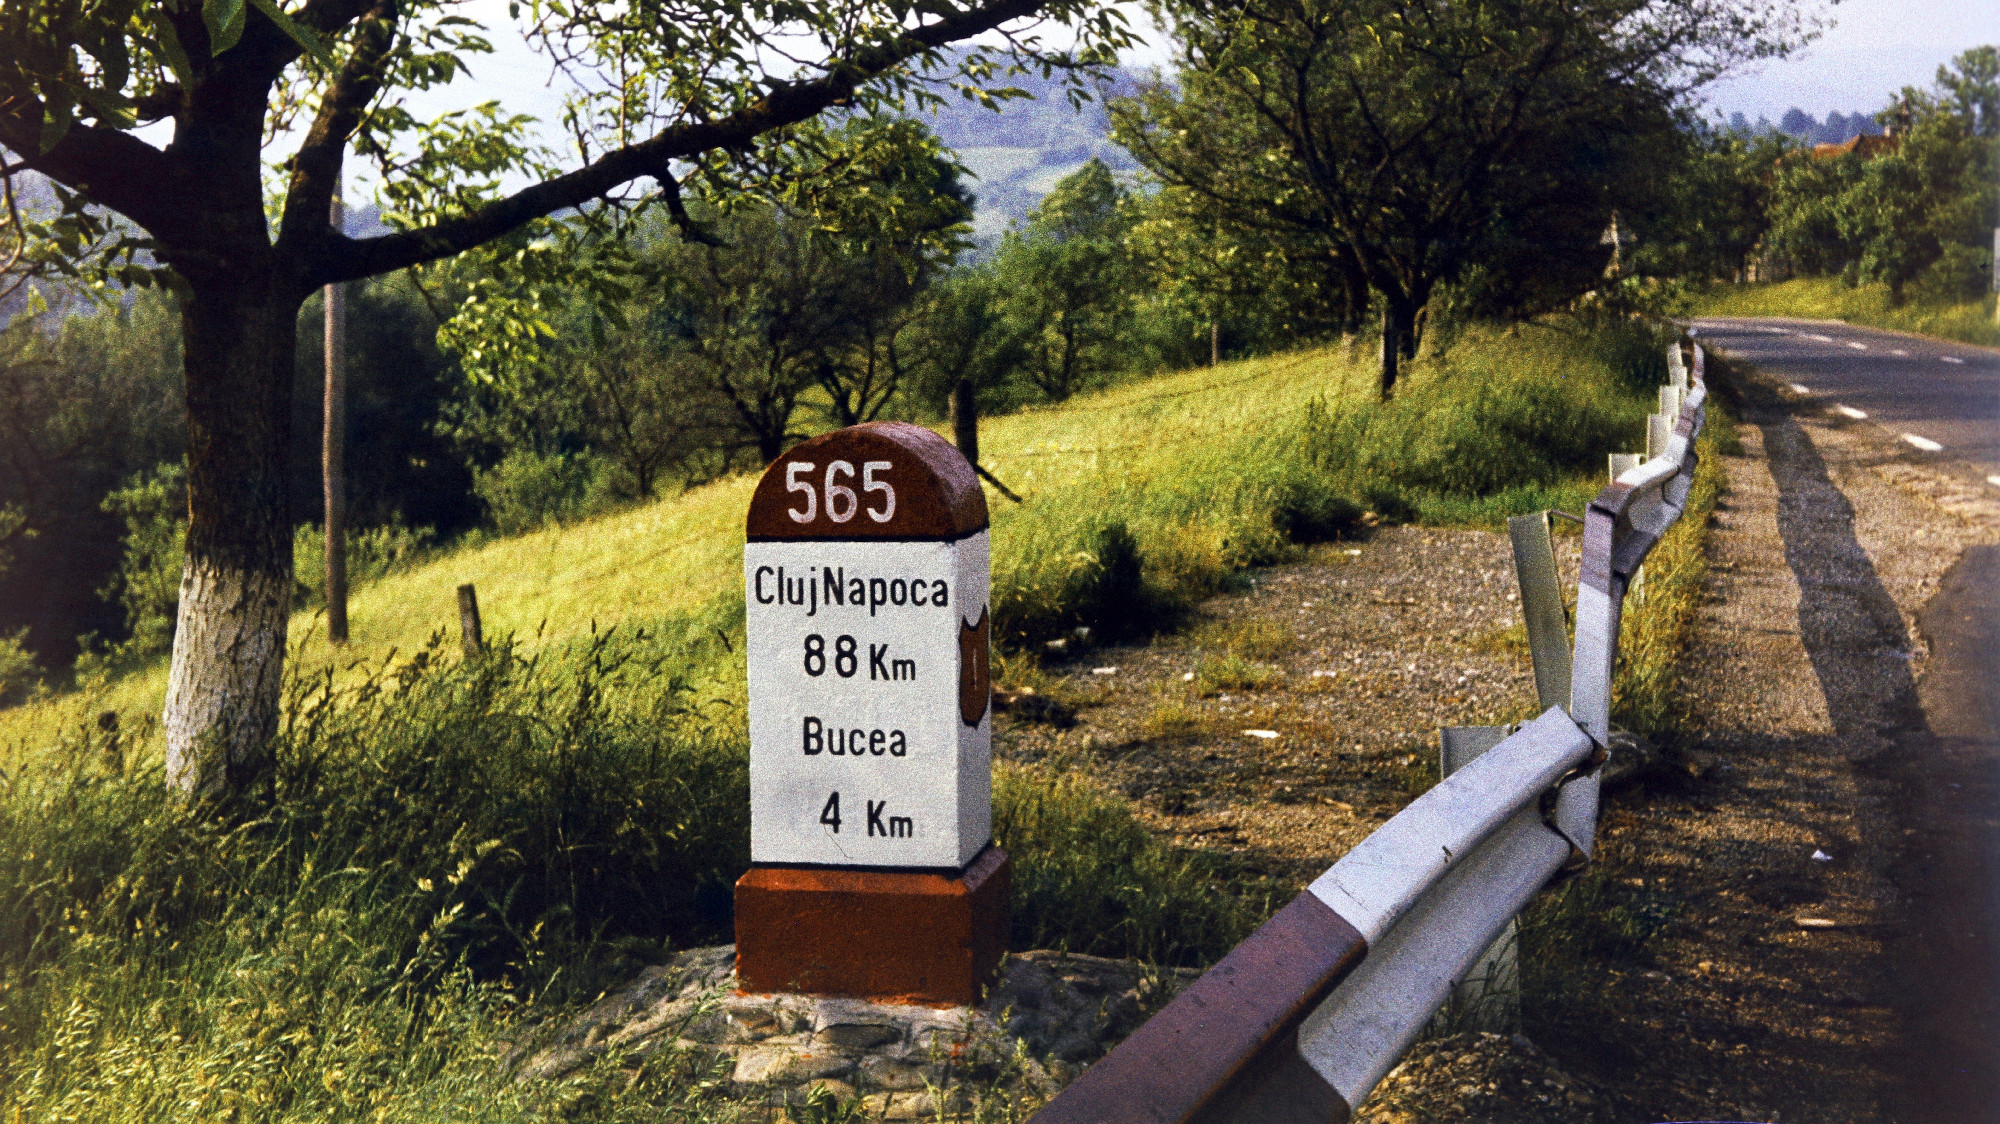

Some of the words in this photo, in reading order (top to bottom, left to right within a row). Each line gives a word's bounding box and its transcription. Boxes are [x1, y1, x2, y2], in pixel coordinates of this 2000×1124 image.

[785, 459, 896, 524] 565
[803, 633, 859, 678] 88
[869, 642, 916, 681] Km
[802, 715, 907, 757] Bucea
[819, 790, 842, 834] 4
[866, 799, 914, 838] Km
